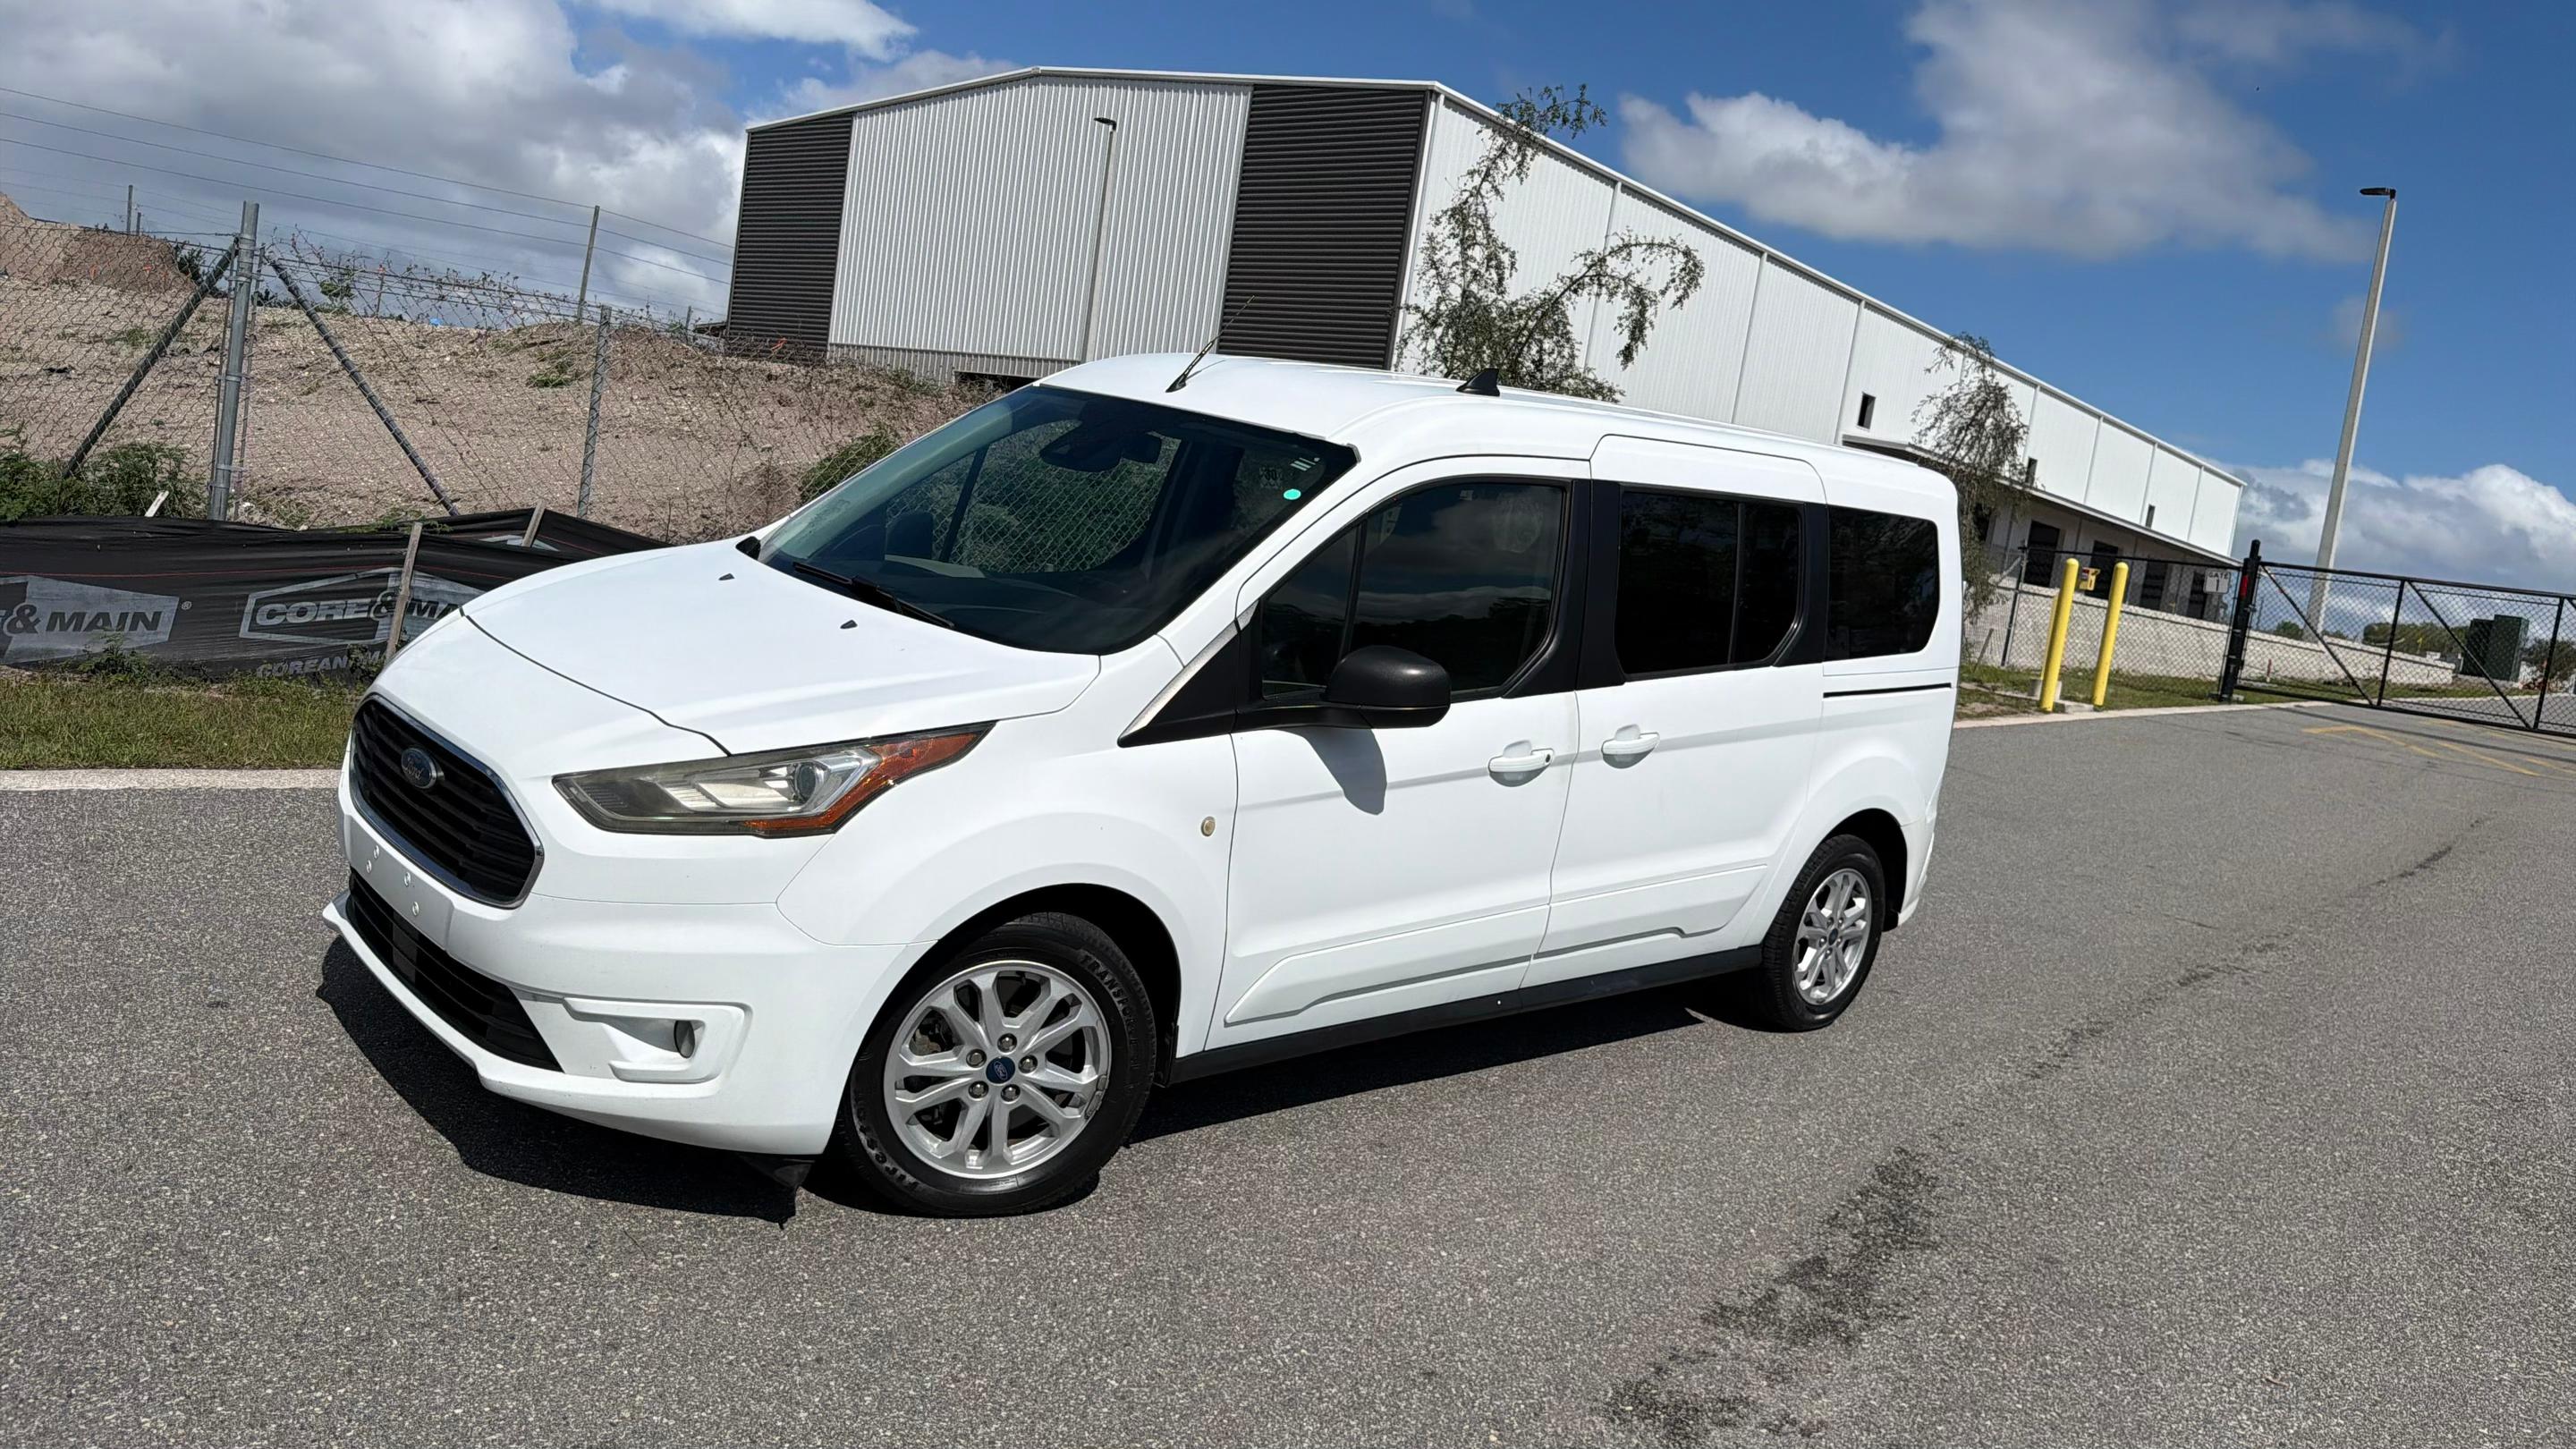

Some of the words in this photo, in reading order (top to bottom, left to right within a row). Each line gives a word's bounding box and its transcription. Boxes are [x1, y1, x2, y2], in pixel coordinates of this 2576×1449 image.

[2208, 572, 2229, 580] GATE
[2216, 579, 2220, 592] 1
[255, 597, 372, 625] CORE
[45, 610, 163, 632] MAIN
